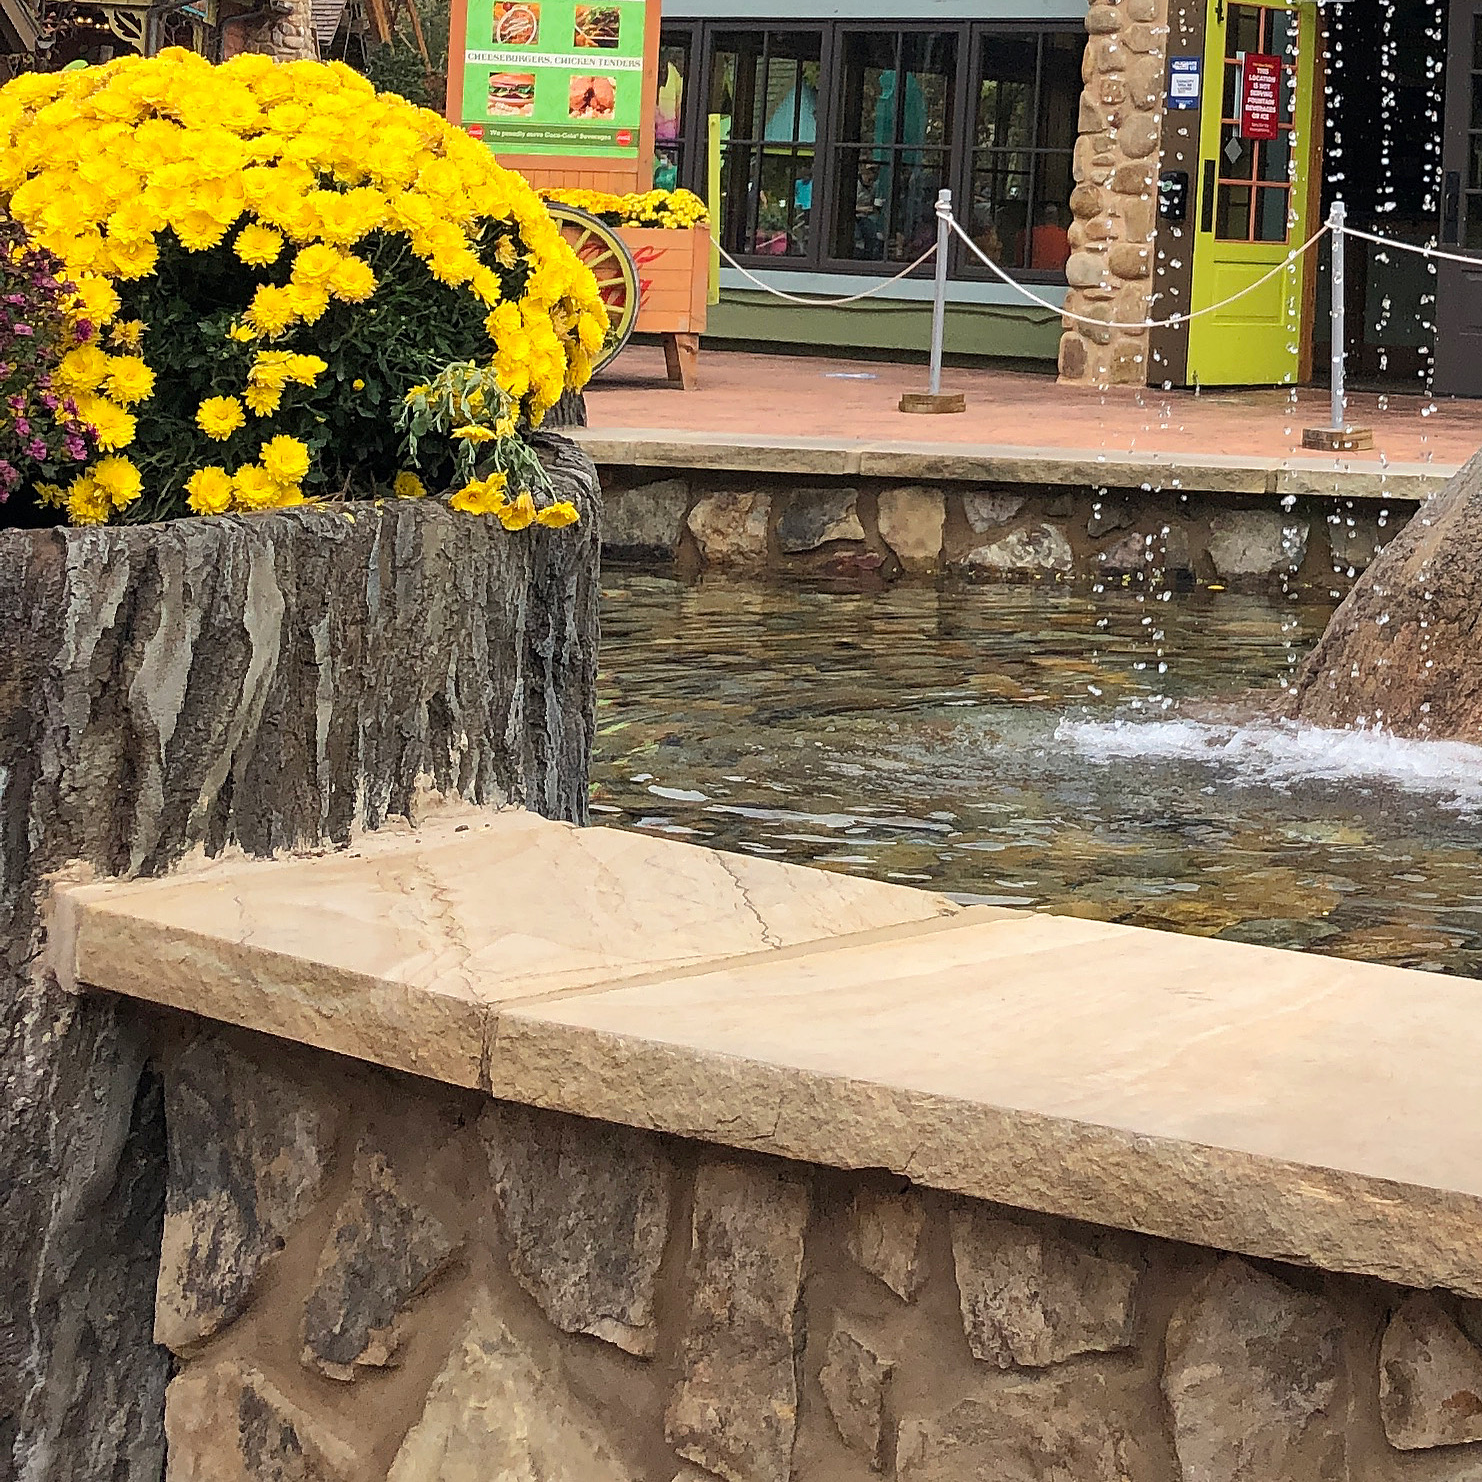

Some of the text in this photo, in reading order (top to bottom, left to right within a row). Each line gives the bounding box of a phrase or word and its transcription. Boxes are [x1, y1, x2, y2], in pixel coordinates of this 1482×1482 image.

[555, 56, 596, 66] CHICKEN
[598, 58, 641, 68] TENDERS
[1249, 74, 1276, 83] LOCATION
